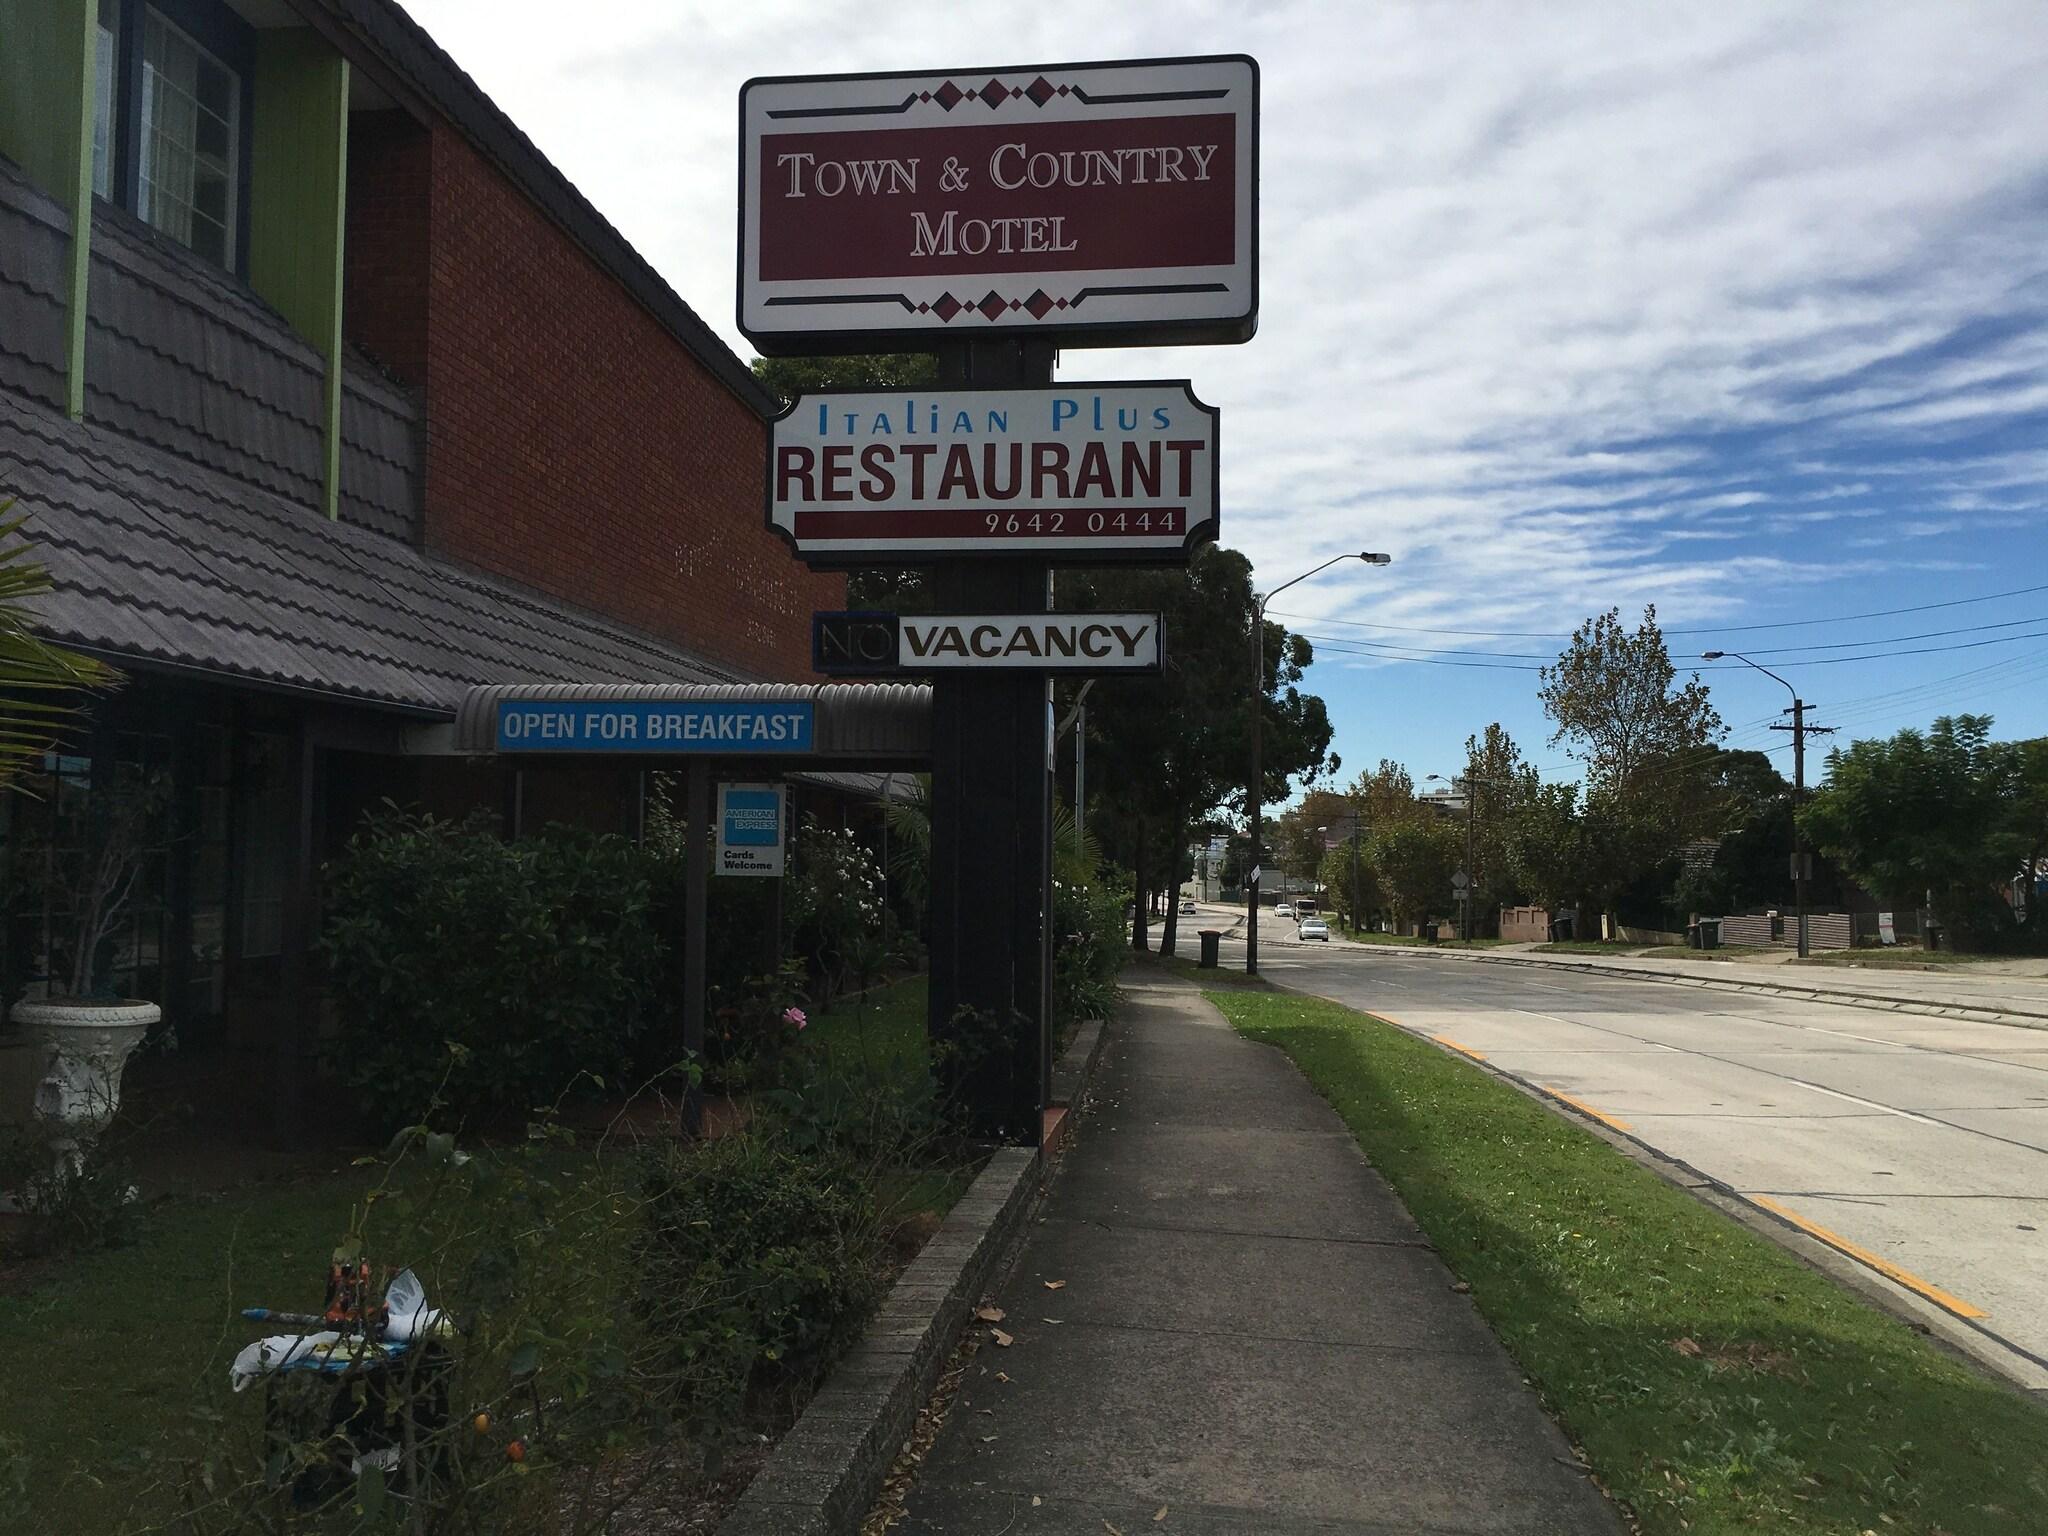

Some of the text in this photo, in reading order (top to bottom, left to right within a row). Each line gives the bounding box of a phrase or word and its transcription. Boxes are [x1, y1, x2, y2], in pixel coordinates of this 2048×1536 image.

[939, 156, 969, 192] &
[777, 439, 1205, 502] RESTAURANT
[985, 512, 1176, 533] 9642 0444
[822, 623, 1149, 660] NO VACANCY
[504, 713, 804, 740] OPEN FOR BREAKFAST
[725, 808, 775, 819] AMERICAN
[735, 820, 777, 830] EXPRESS
[724, 850, 754, 859] Cards
[724, 861, 772, 870] Welcome
